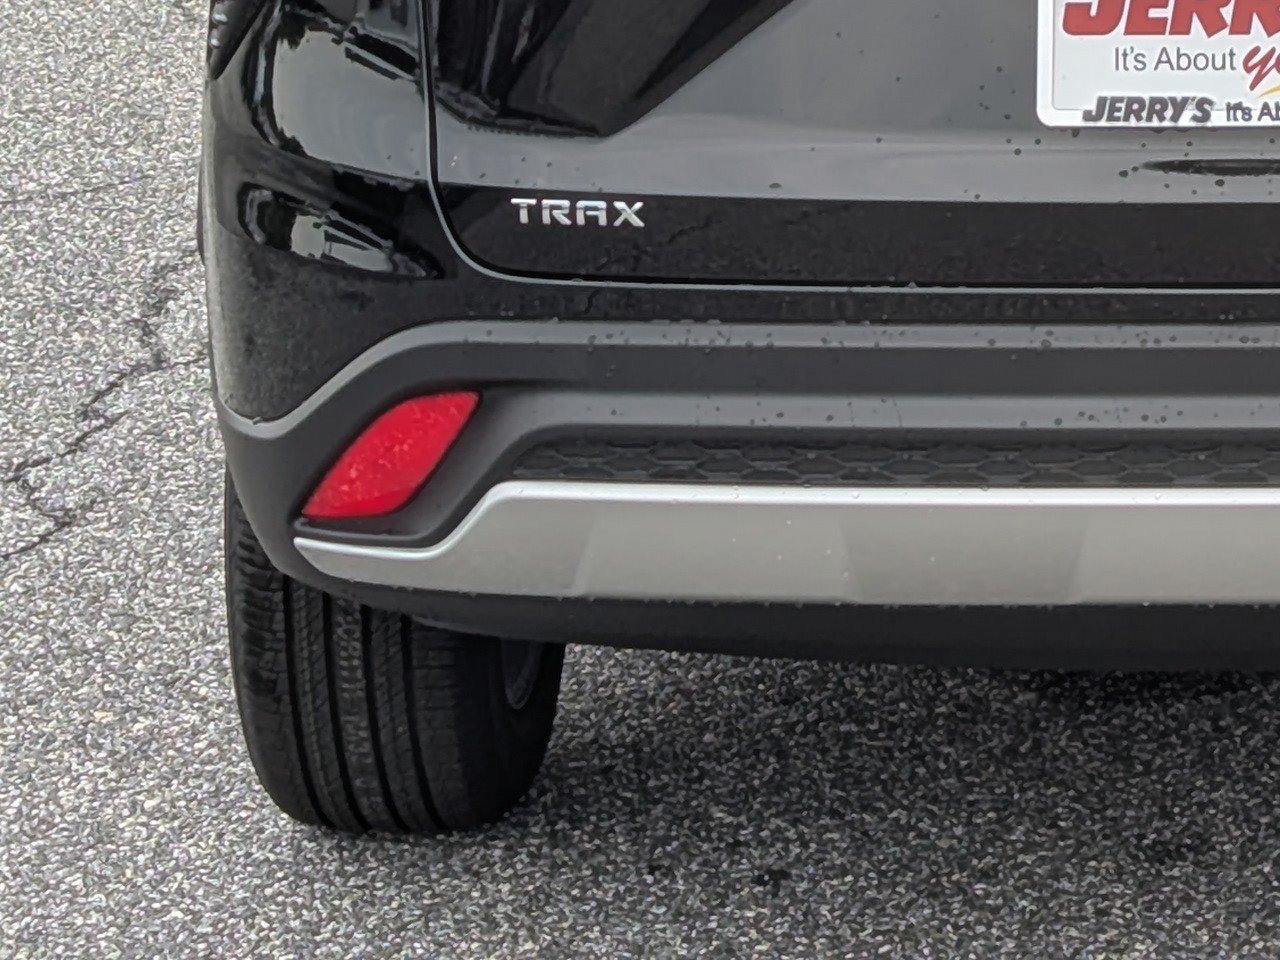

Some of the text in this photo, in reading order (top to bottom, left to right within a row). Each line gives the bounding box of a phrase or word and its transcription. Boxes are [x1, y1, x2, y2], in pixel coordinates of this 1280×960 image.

[1114, 46, 1147, 71] It's
[1153, 46, 1237, 71] About
[1082, 96, 1215, 123] JERRY'S
[1226, 102, 1253, 122] It's
[510, 197, 646, 227] TRAX
